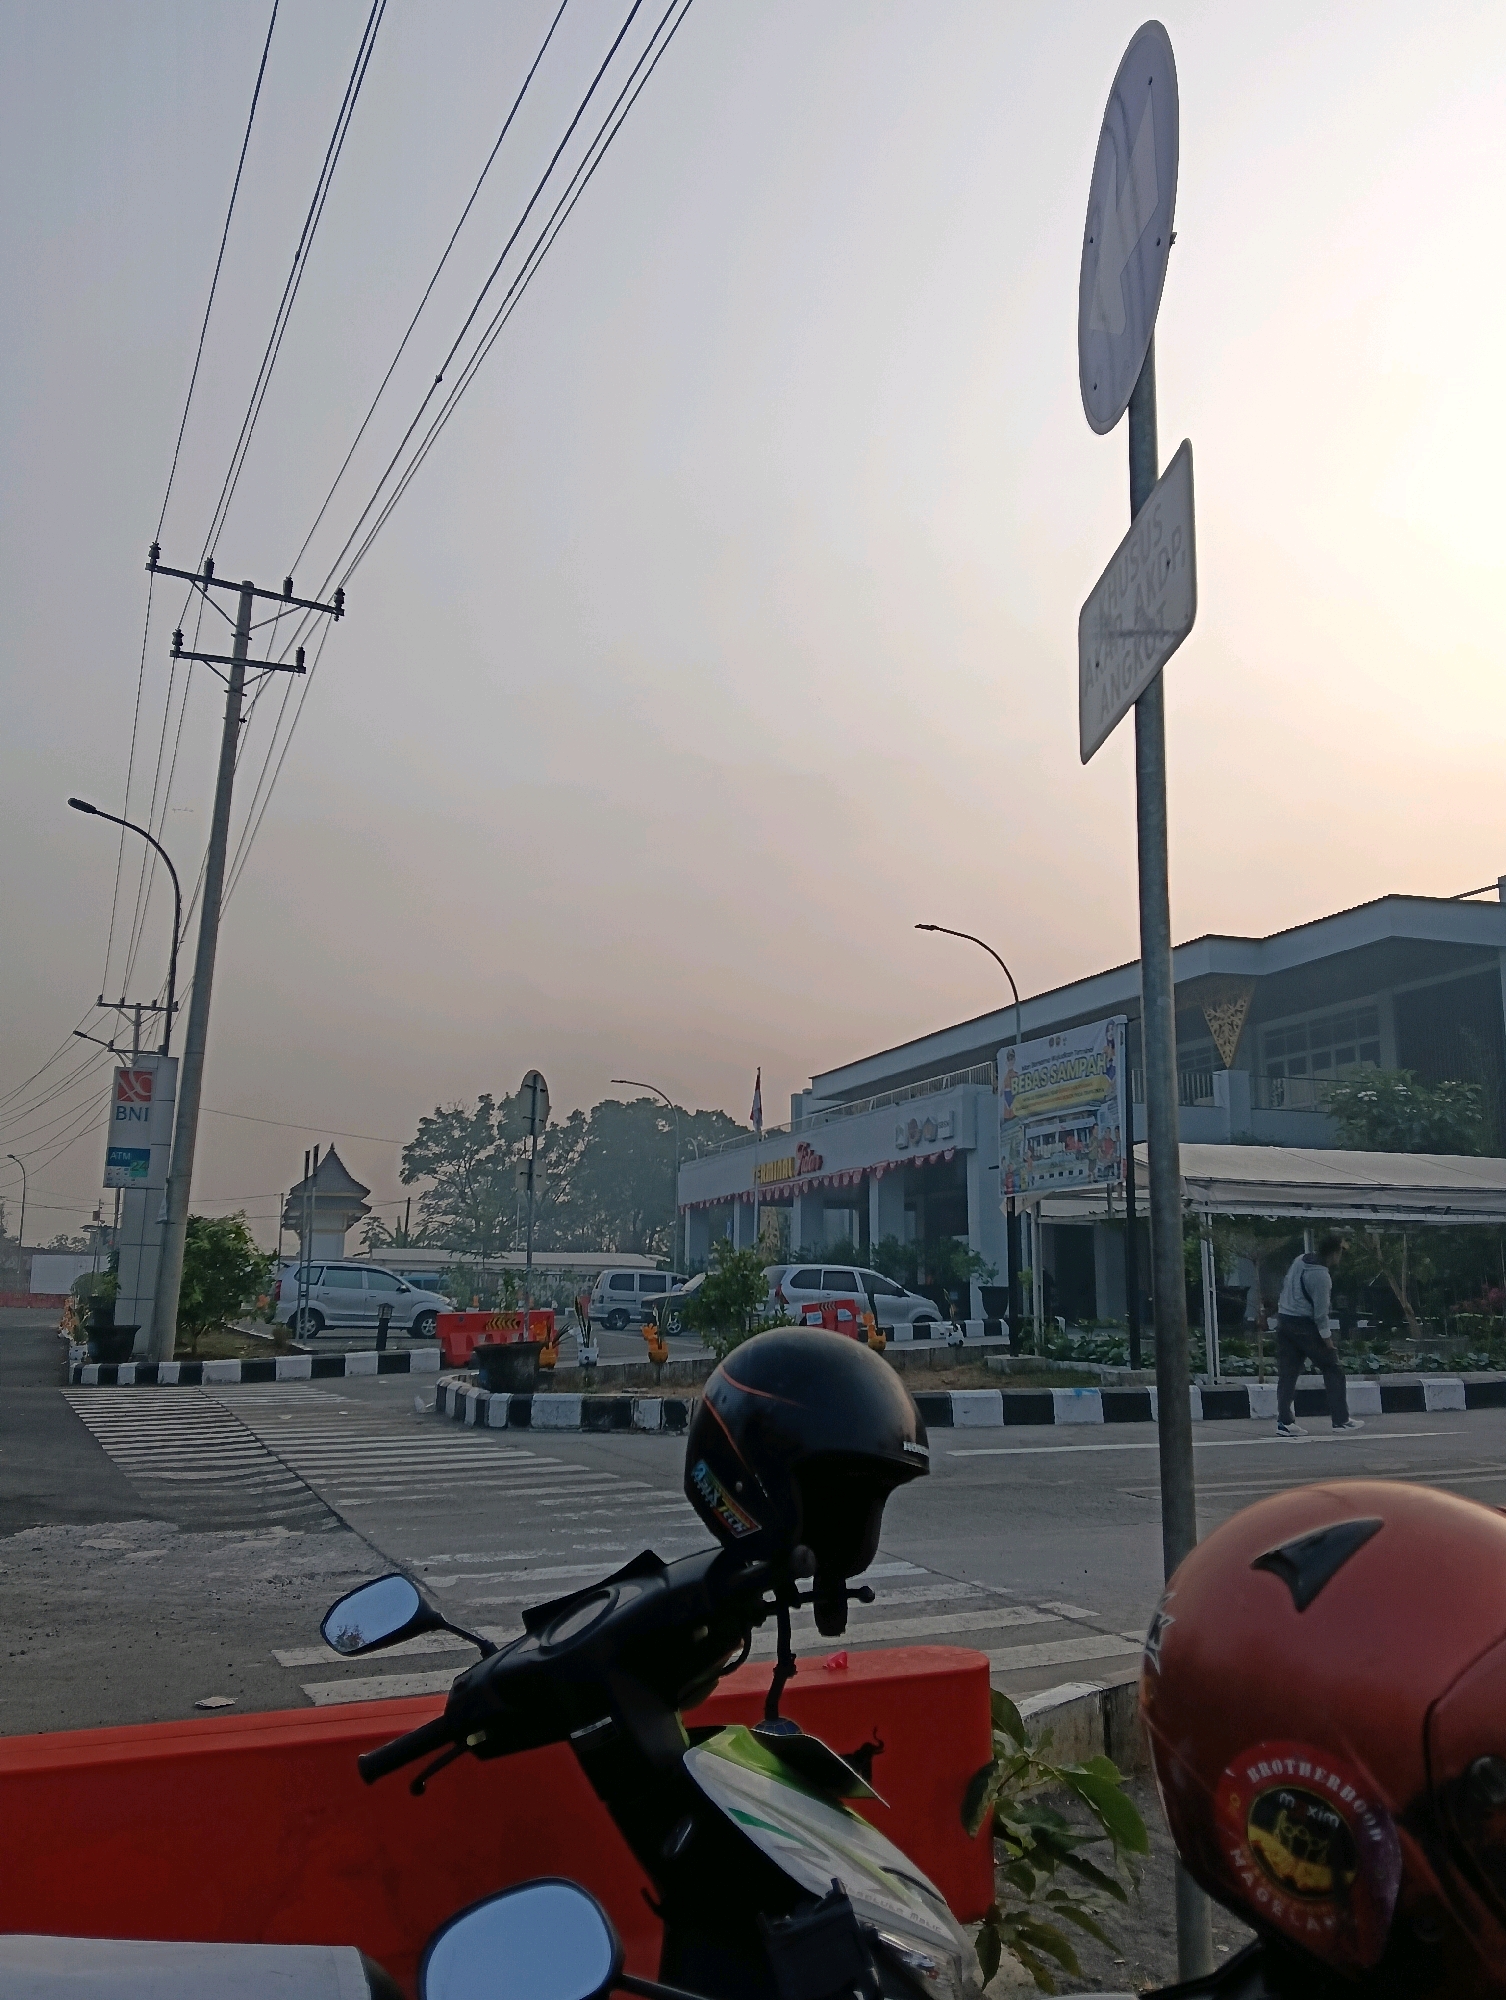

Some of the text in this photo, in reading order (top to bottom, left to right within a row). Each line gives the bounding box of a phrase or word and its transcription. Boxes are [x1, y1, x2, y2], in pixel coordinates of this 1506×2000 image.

[1098, 501, 1162, 638] KHUSUS
[1100, 599, 1166, 723] ANGKOT
[1010, 1066, 1049, 1095] BEBAS
[1049, 1053, 1107, 1085] SAMPAH
[115, 1105, 149, 1122] BNI
[110, 1151, 131, 1161] ATM
[130, 1160, 149, 1172] 24
[752, 1156, 796, 1184] TERMINAL
[1246, 1758, 1382, 1842] BROTHERHOOD
